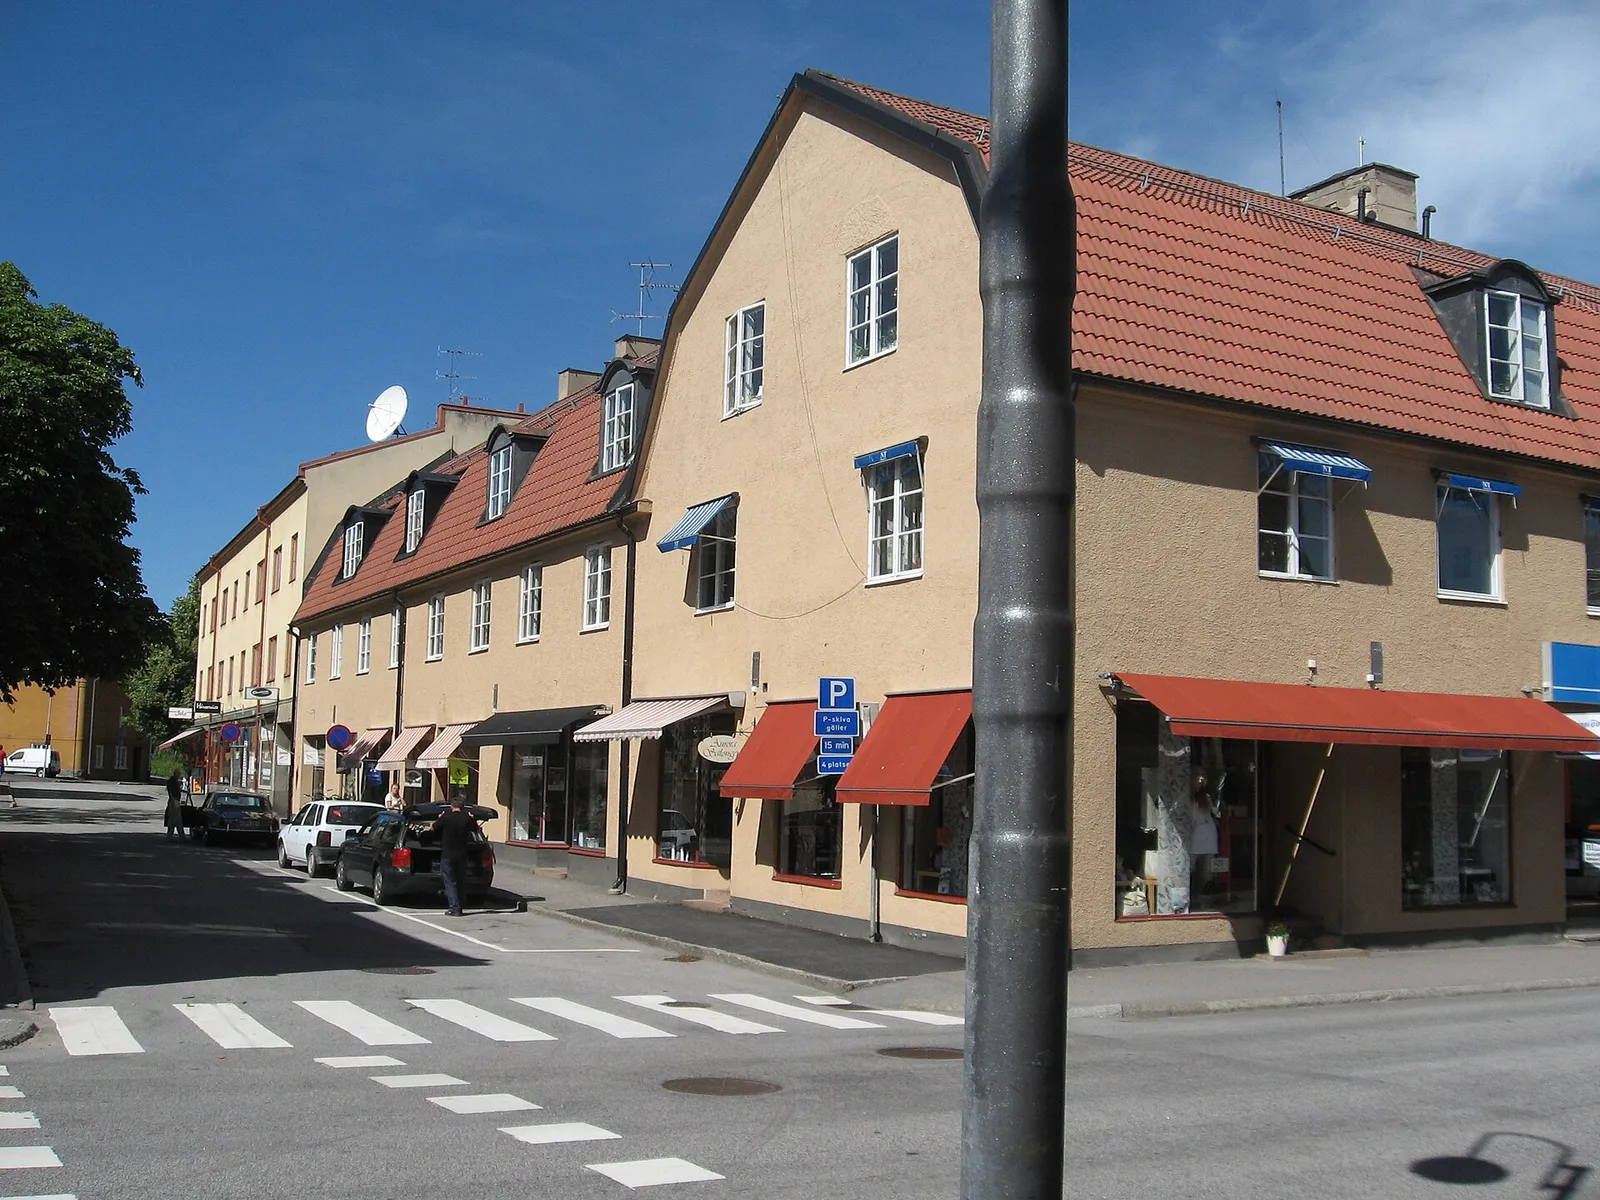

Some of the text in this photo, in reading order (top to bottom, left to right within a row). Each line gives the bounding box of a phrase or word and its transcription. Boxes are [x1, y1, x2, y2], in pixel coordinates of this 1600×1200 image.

[830, 680, 847, 707] P
[822, 715, 851, 723] P-skiva
[826, 724, 848, 733] gäller
[824, 740, 850, 750] 15 min
